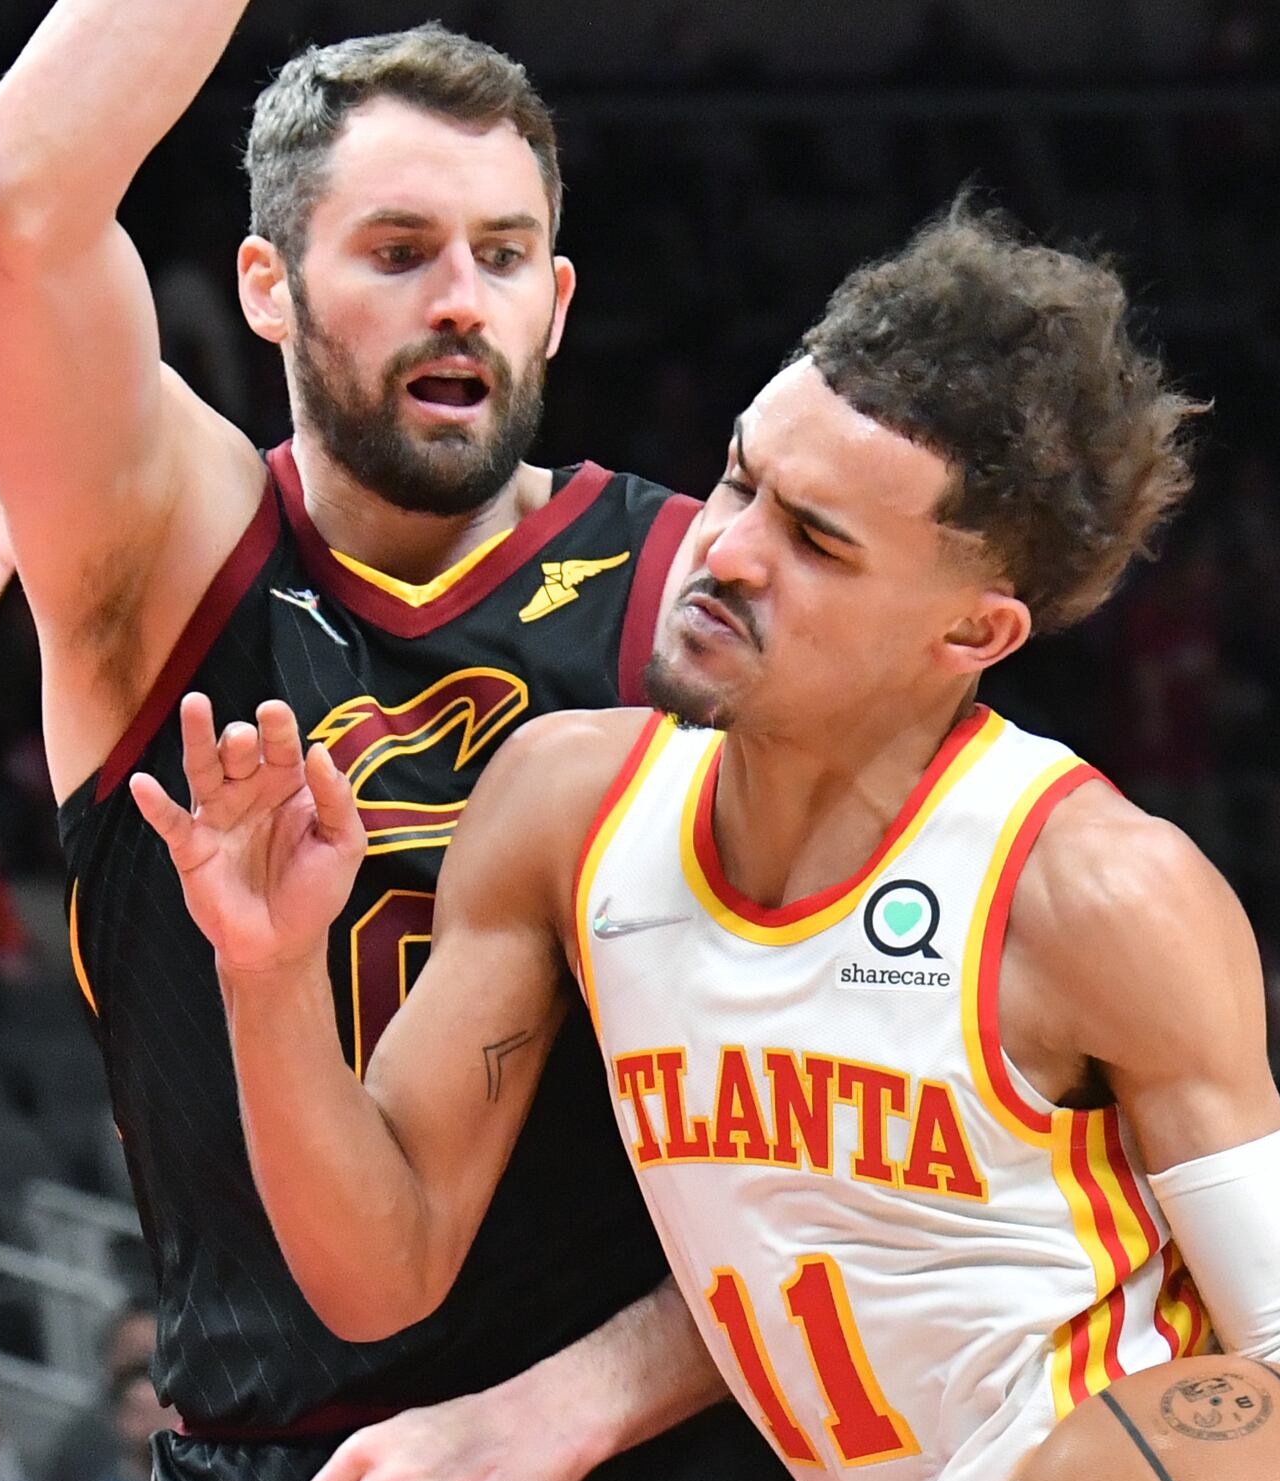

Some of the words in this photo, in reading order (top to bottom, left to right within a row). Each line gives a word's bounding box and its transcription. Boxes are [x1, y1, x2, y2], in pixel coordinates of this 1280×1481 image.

[840, 963, 951, 987] sharecare
[612, 1045, 989, 1204] TLANTA
[705, 1252, 922, 1468] 11
